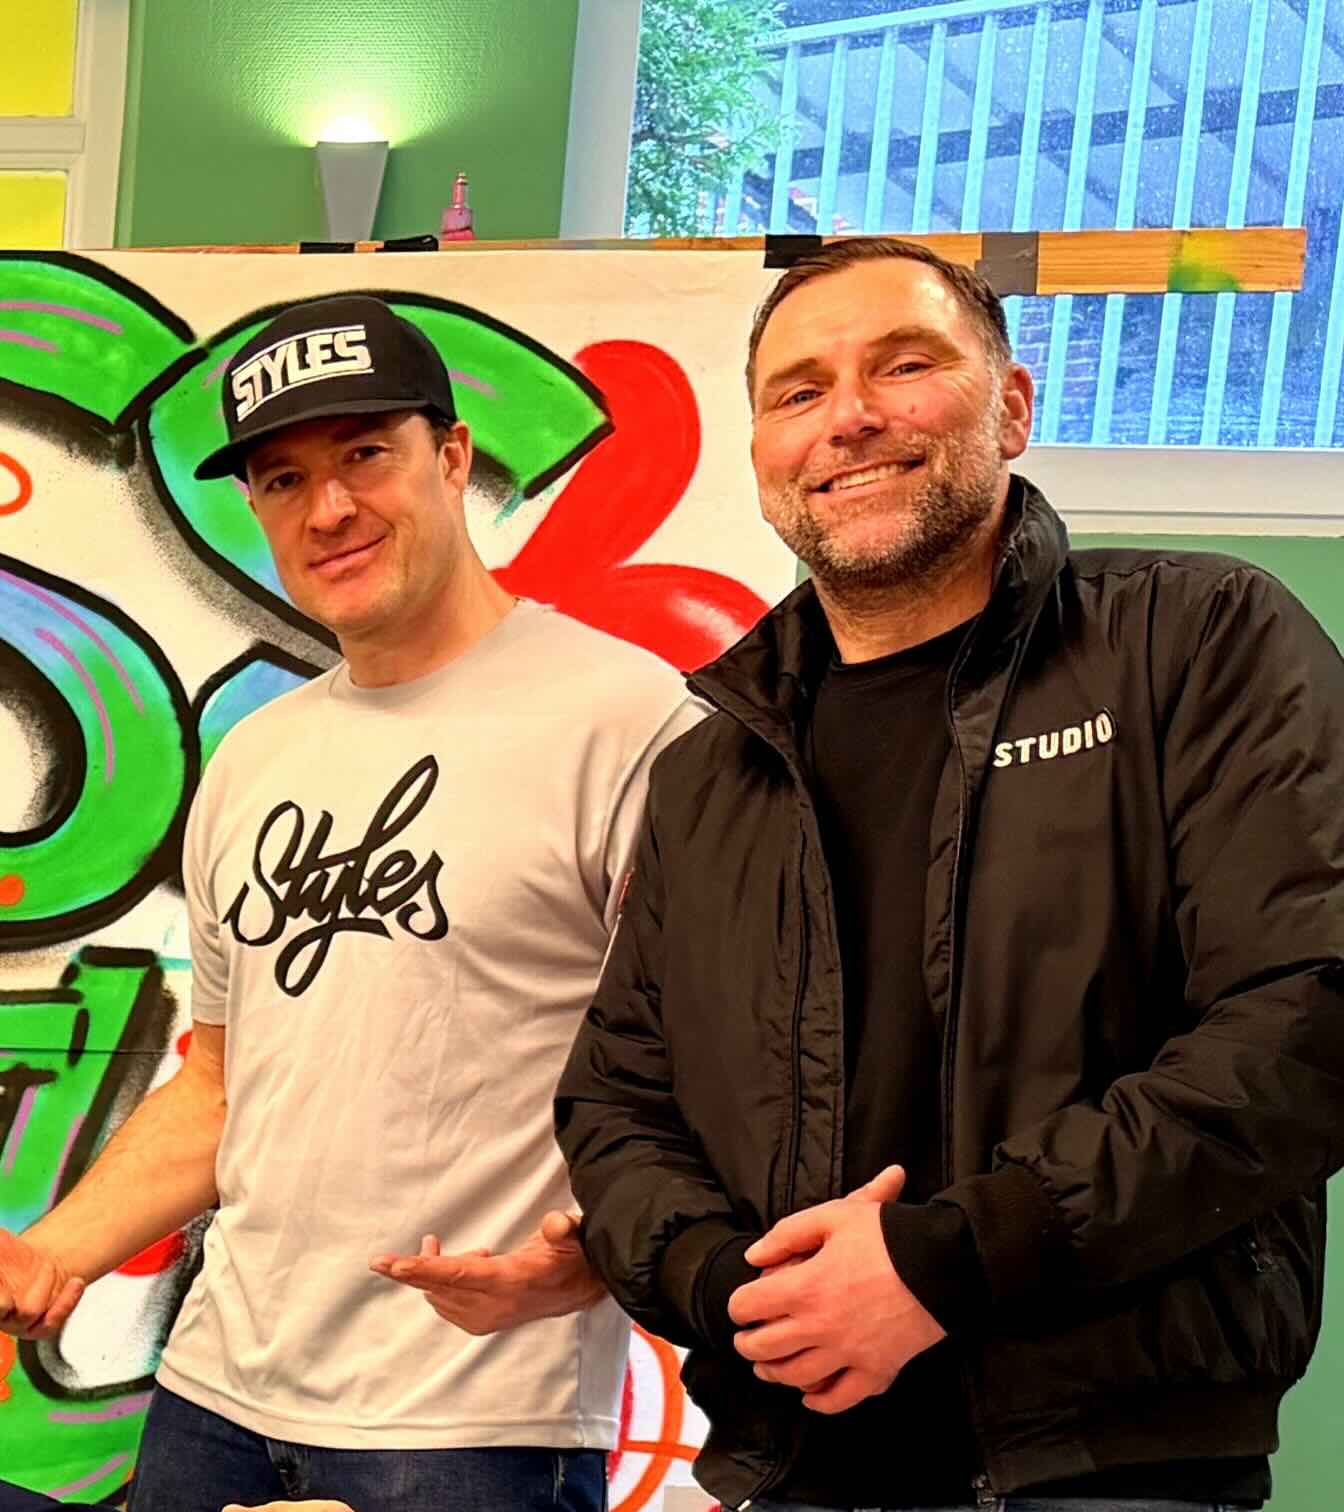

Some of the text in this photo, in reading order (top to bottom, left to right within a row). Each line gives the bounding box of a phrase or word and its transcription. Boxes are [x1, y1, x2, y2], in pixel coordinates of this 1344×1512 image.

[231, 325, 374, 421] STYLES
[992, 712, 1114, 768] STUDIO
[220, 754, 450, 998] Styles
